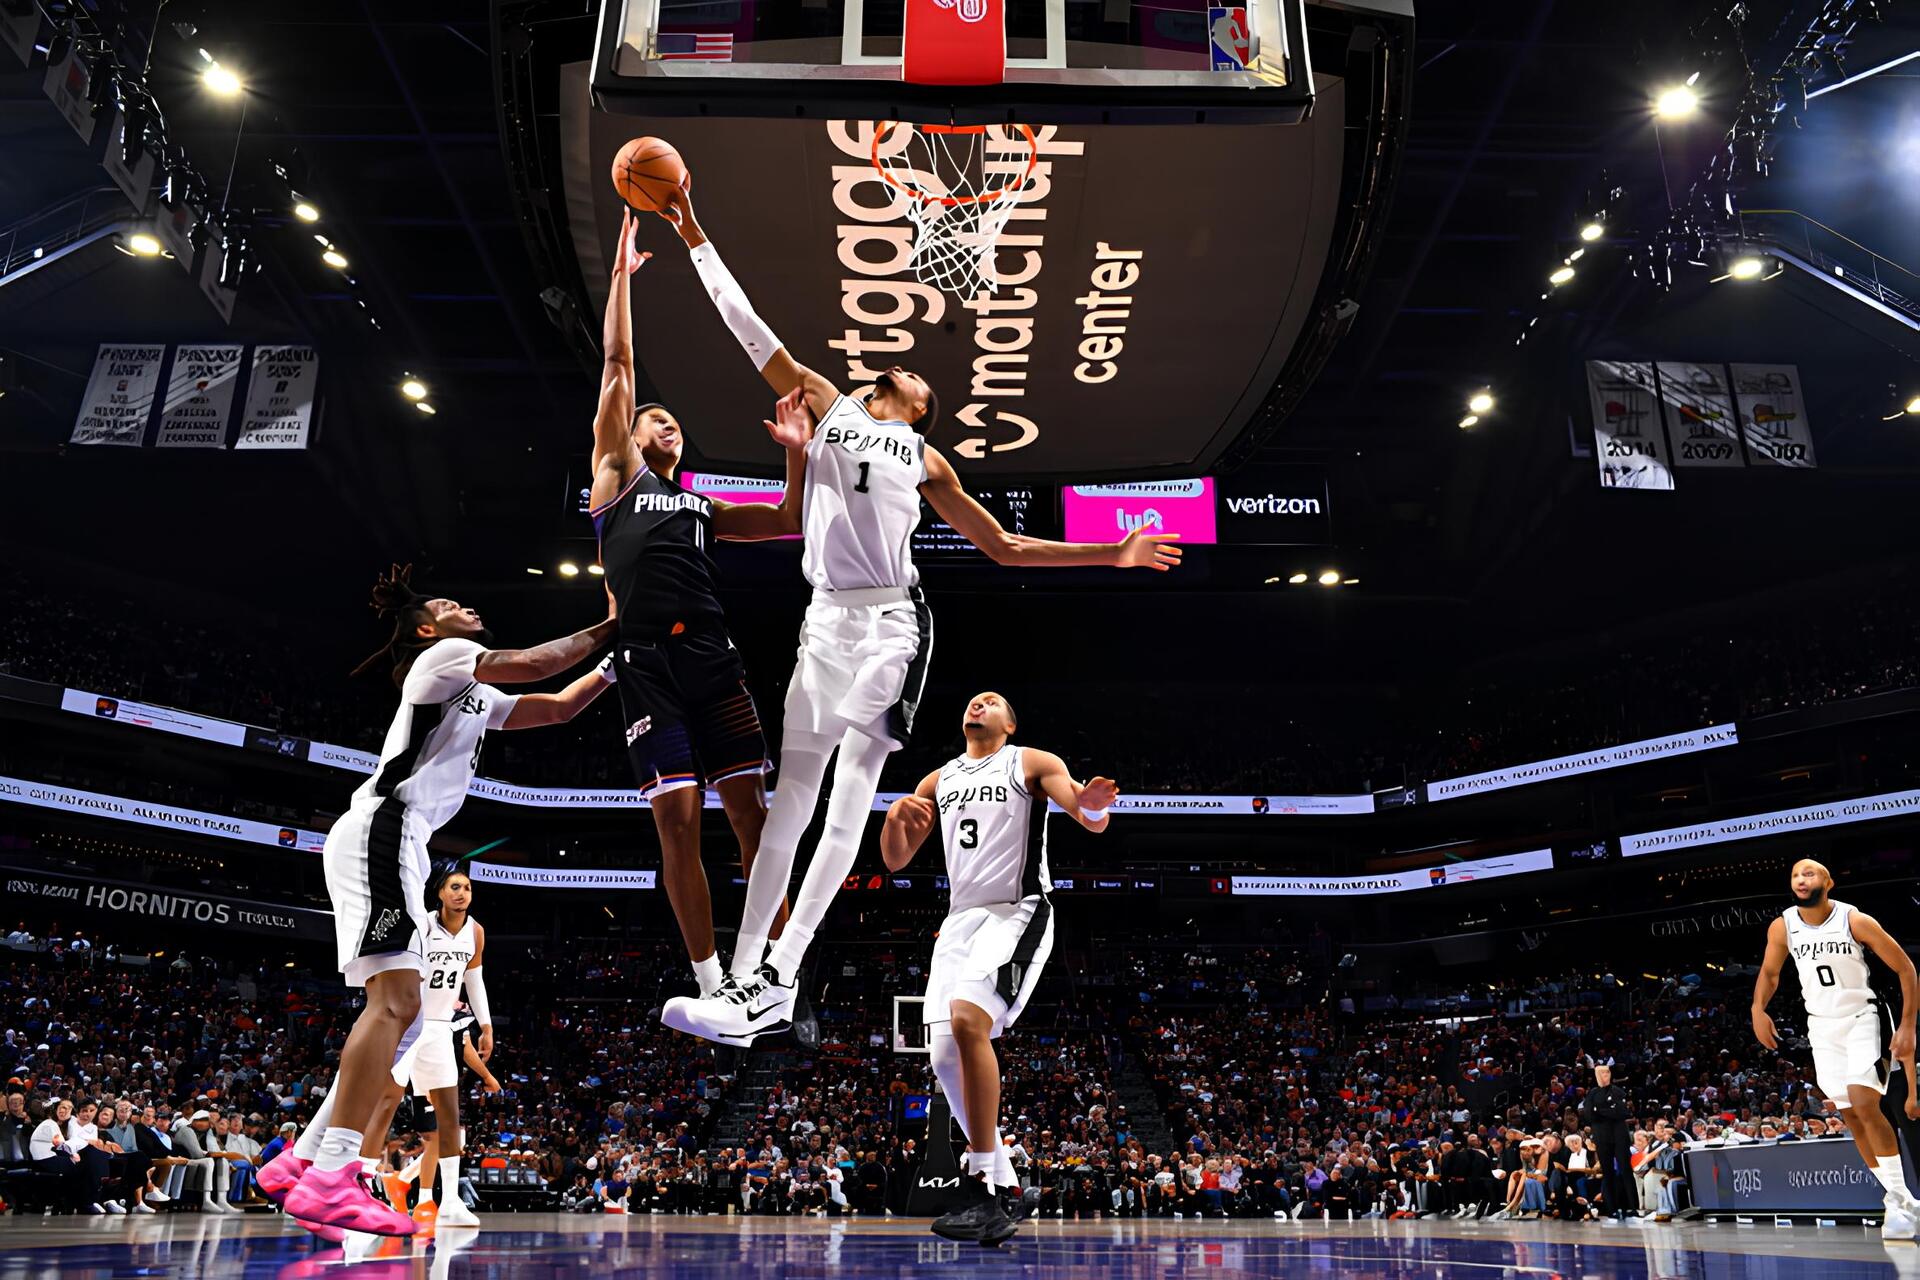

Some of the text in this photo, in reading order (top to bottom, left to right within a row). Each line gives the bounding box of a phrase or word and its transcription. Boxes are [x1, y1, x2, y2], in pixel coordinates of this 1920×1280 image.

[1073, 241, 1143, 384] center
[854, 461, 870, 494] 1
[1225, 493, 1321, 514] verizon
[959, 818, 978, 850] 3
[85, 885, 231, 925] HORNITOS
[429, 969, 458, 990] 24
[1815, 964, 1836, 987] 0
